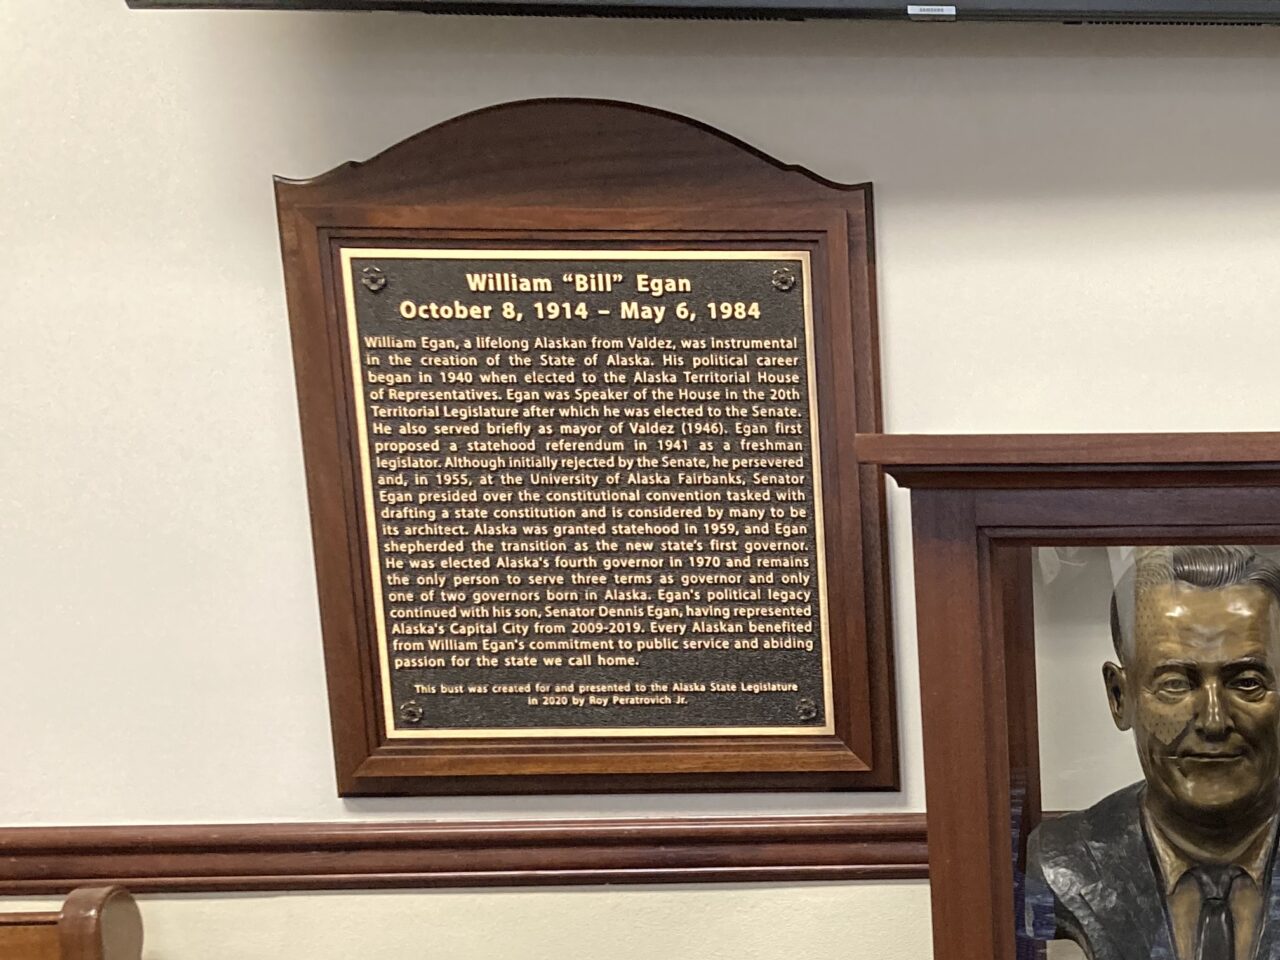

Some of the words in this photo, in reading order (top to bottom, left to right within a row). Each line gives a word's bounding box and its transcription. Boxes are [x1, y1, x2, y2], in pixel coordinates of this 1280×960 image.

[466, 272, 552, 292] William
[636, 274, 691, 296] Egan
[400, 300, 492, 319] October
[502, 301, 523, 322] 8,
[534, 302, 588, 319] 1914
[620, 301, 666, 324] May
[676, 302, 696, 322] 6,
[707, 302, 761, 320] 1984
[364, 335, 416, 348] William
[421, 336, 459, 352] Egan,
[463, 339, 472, 349] a
[476, 336, 529, 352] lifelong
[534, 336, 587, 349] Alaskan
[591, 335, 624, 349] from
[627, 336, 676, 350] Valdez,
[680, 339, 706, 349] was
[710, 336, 797, 349] instrumental
[366, 352, 380, 365] in
[388, 351, 412, 366] the
[420, 354, 478, 366] creation
[486, 353, 500, 366] of
[508, 353, 532, 366] the
[540, 354, 575, 366] State
[584, 353, 598, 366] of
[606, 353, 654, 366] Alaska.
[662, 354, 684, 366] His
[692, 353, 748, 368] political
[756, 356, 798, 366] career
[368, 370, 412, 386] began
[418, 371, 432, 383] in
[440, 371, 473, 383] 1940
[479, 370, 517, 383] when
[524, 370, 575, 383] elected
[582, 372, 596, 383] to
[604, 370, 626, 383] the
[634, 370, 677, 383] Alaska
[683, 370, 750, 383] Territorial
[758, 371, 800, 383] House
[369, 387, 384, 400] of
[388, 388, 502, 403] Representatives.
[506, 388, 540, 403] Egan
[544, 390, 570, 400] was
[574, 387, 628, 403] Speaker
[633, 388, 648, 400] of
[651, 387, 674, 400] the
[678, 388, 720, 400] House
[725, 387, 738, 400] in
[742, 388, 765, 400] the
[770, 385, 800, 400] 20th
[372, 422, 392, 434] He
[399, 422, 427, 434] also
[434, 422, 479, 434] served
[486, 422, 531, 437] briefly
[538, 424, 553, 434] as
[560, 424, 602, 437] mayor
[609, 421, 624, 434] of
[629, 422, 675, 434] Valdez
[682, 421, 728, 435] (1946).
[735, 422, 768, 437] Egan
[775, 420, 802, 434] first
[378, 472, 408, 487] and,
[414, 473, 428, 485] in
[436, 472, 472, 488] 1955,
[480, 473, 493, 485] at
[498, 472, 523, 485] the
[530, 472, 599, 487] University
[606, 472, 620, 484] of
[627, 471, 670, 484] Alaska
[678, 472, 746, 486] Fairbanks,
[753, 472, 805, 484] Senator
[382, 523, 399, 536] its
[404, 523, 469, 536] architect.
[474, 522, 517, 535] Alaska
[522, 525, 548, 535] was
[553, 522, 606, 538] granted
[611, 522, 679, 535] statehood
[684, 522, 698, 534] in
[704, 522, 739, 536] 1959,
[744, 522, 769, 534] and
[775, 522, 807, 537] Egan
[385, 557, 404, 569] He
[409, 559, 435, 569] was
[440, 556, 490, 568] elected
[496, 556, 550, 568] Alaska's
[554, 555, 597, 568] fourth
[603, 558, 664, 570] governor
[669, 556, 682, 567] in
[689, 556, 720, 568] 1970
[726, 555, 751, 568] and
[757, 556, 809, 568] remains
[392, 622, 445, 634] Alaska's
[450, 622, 497, 636] Capital
[502, 622, 529, 636] City
[534, 621, 566, 634] from
[571, 621, 645, 634] 2009-2019.
[650, 621, 687, 636] Every
[692, 620, 743, 633] Alaskan
[748, 620, 812, 633] benefited
[414, 684, 436, 694] This
[440, 683, 464, 694] bust
[468, 684, 488, 693] was
[492, 683, 531, 693] created
[535, 682, 550, 692] for
[555, 683, 574, 692] and
[579, 682, 631, 694] presented
[635, 683, 646, 692] to
[650, 680, 668, 692] the
[672, 682, 706, 692] Alaska
[710, 681, 737, 692] State
[741, 682, 798, 694] Legislature
[528, 696, 538, 705] in
[542, 695, 568, 705] 2020
[572, 696, 585, 707] by
[589, 695, 608, 707] Roy
[612, 695, 672, 705] Peratrovich
[676, 695, 688, 704] Jr.
